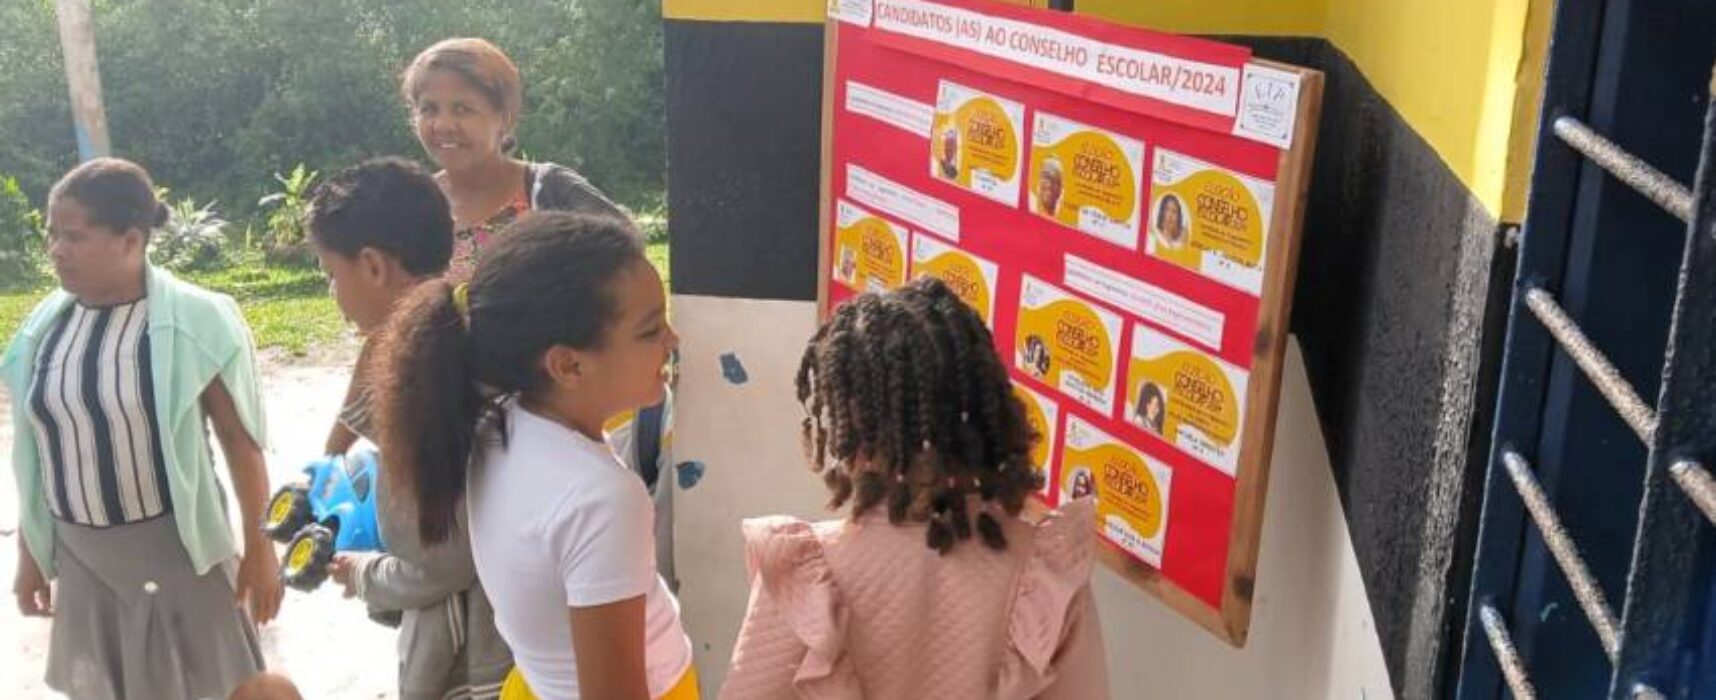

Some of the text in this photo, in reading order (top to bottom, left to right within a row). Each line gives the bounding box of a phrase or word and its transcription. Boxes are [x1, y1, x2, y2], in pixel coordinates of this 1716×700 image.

[877, 3, 951, 32] CANDIDATOS
[956, 19, 982, 41] (AS)
[985, 26, 1006, 45] AO
[1009, 31, 1088, 67] CONSELHO
[1096, 53, 1226, 97] ESCOLAR/2024
